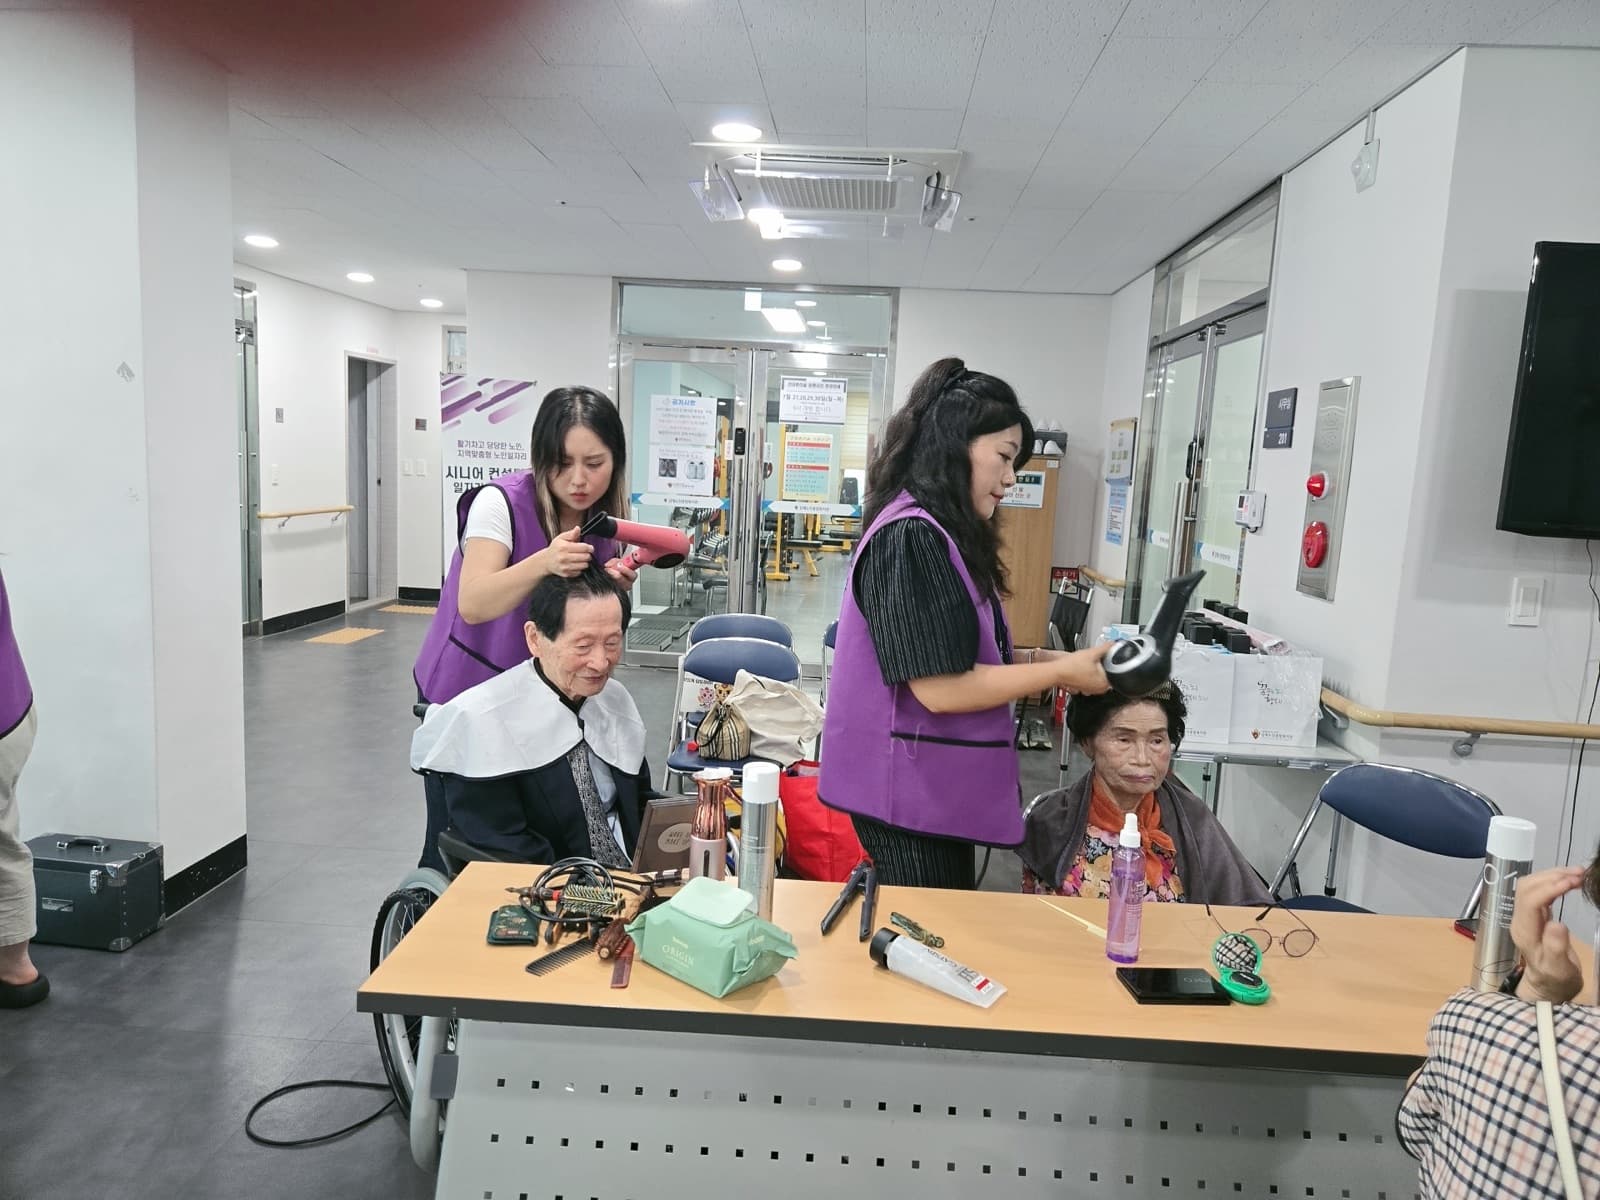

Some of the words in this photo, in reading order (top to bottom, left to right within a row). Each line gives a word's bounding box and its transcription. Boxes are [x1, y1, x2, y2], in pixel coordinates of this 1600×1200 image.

[457, 440, 485, 449] 활기차고
[486, 441, 507, 450] 당당한
[457, 450, 492, 459] 지역맞춤형
[493, 452, 527, 460] 노인일자리
[445, 466, 483, 480] 시니어
